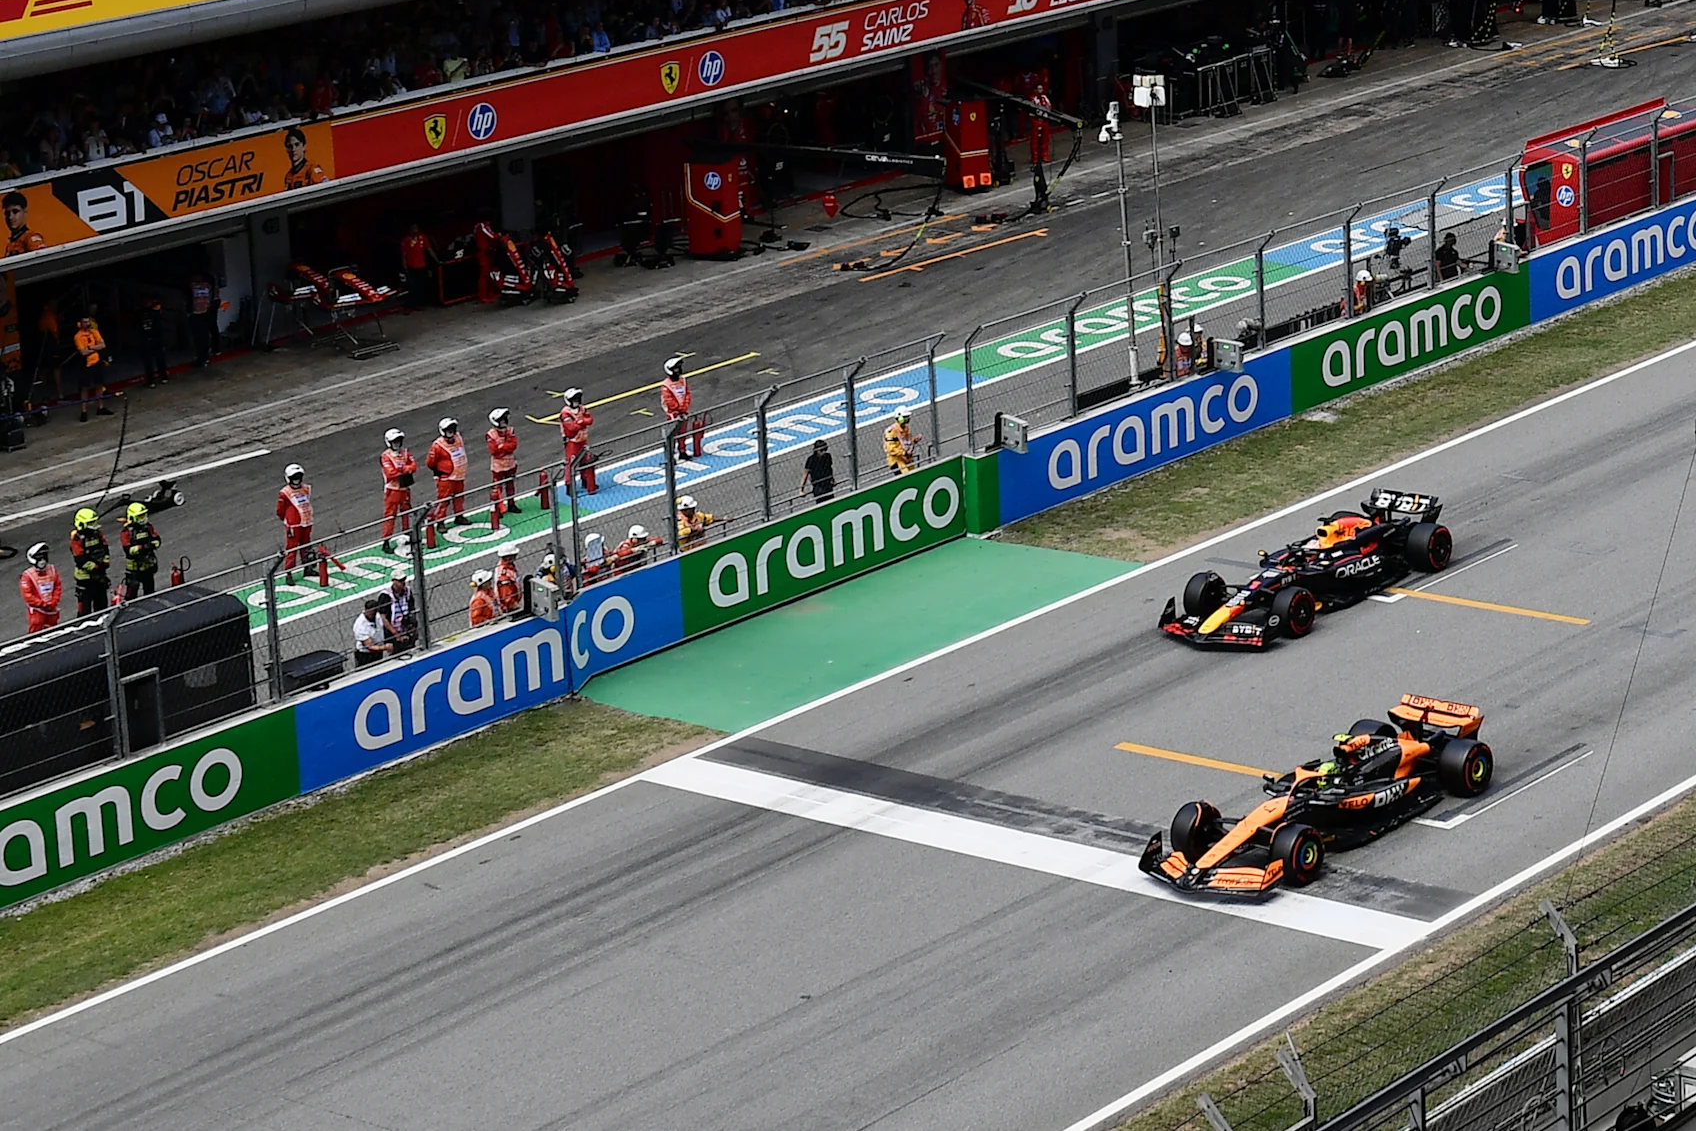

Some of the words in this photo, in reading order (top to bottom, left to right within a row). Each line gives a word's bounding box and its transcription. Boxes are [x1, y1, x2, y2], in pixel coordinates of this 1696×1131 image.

[809, 20, 850, 64] 55
[864, 0, 930, 31] CARLOS
[861, 23, 914, 52] SAINZ
[700, 53, 723, 85] hp
[469, 105, 495, 138] hp
[865, 154, 889, 163] CEVA
[78, 181, 146, 232] 81
[176, 151, 256, 187] OSCAR
[172, 172, 265, 212] PIASTRI
[706, 173, 720, 189] hp
[1557, 186, 1574, 206] hp
[1321, 285, 1502, 388] aramco
[1048, 374, 1260, 491] aramco
[708, 476, 960, 609] aramco
[1336, 554, 1382, 579] ORACLE
[1232, 624, 1263, 637] BYBIT
[353, 595, 635, 751] aramco
[1358, 737, 1396, 761] Chrome
[1340, 796, 1369, 810] VELO
